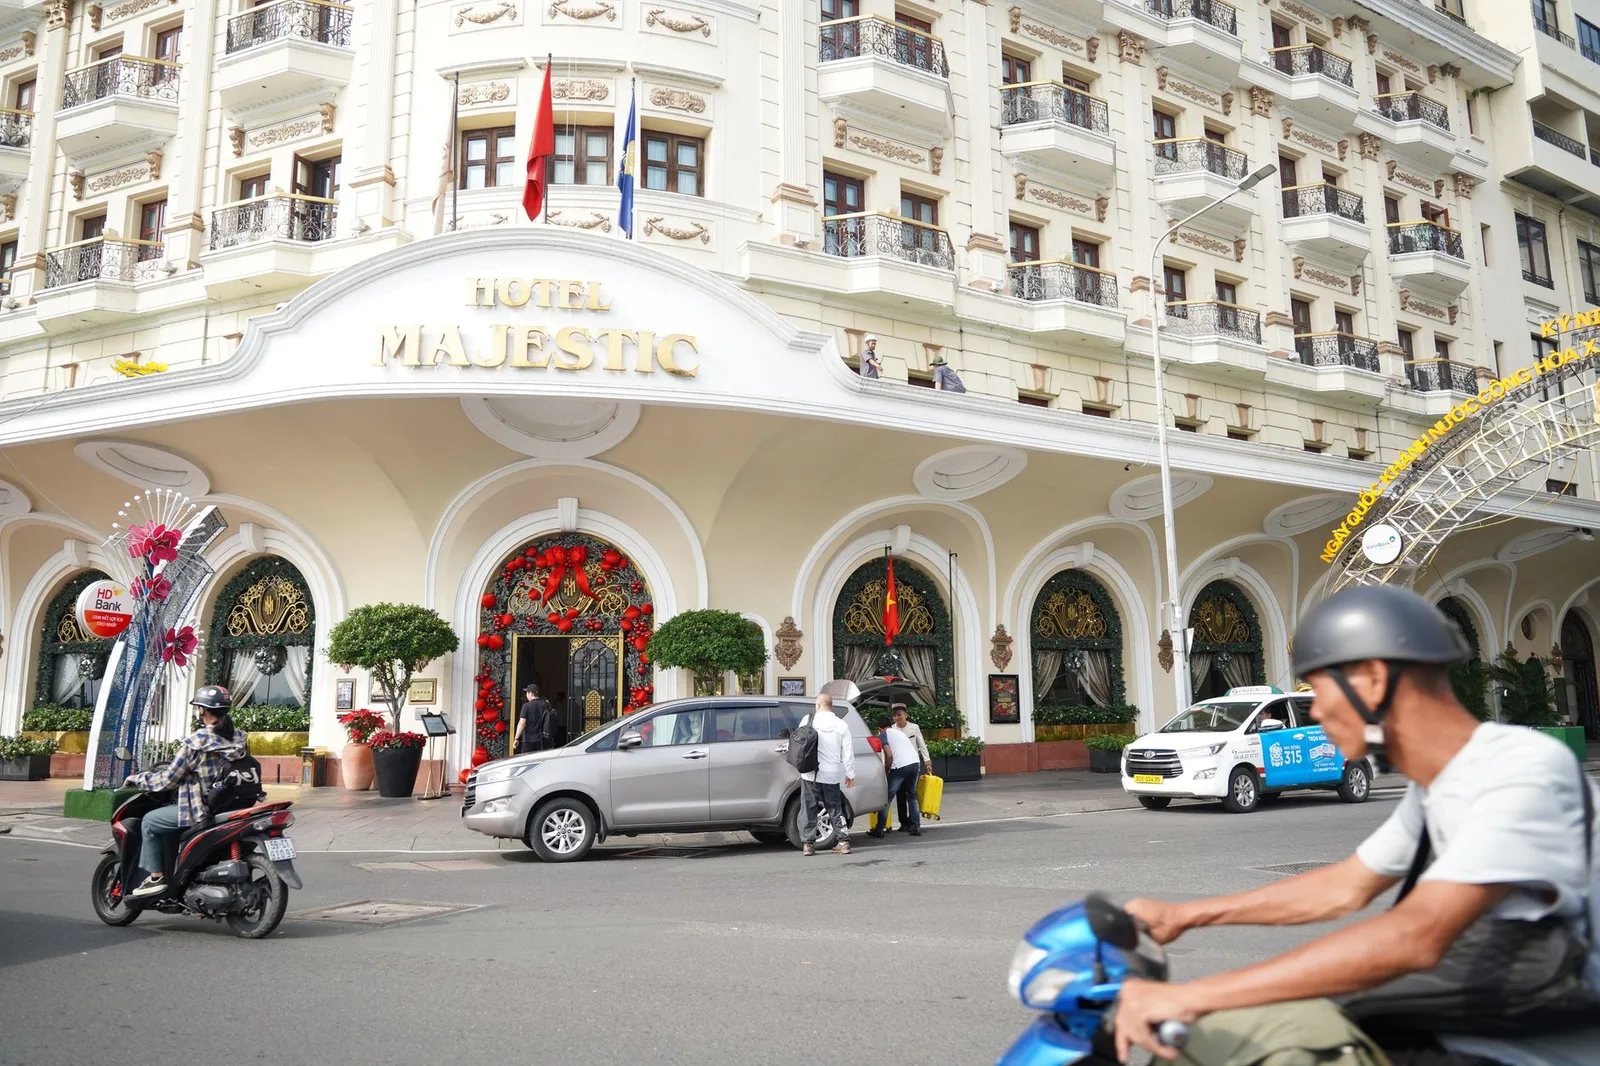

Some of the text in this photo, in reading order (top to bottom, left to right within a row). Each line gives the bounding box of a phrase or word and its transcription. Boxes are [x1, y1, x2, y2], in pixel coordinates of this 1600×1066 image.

[465, 276, 613, 312] HOTEL
[1541, 311, 1571, 338] KỶ
[372, 323, 699, 379] MAJESTIC
[1320, 521, 1351, 564] NGÀY
[1346, 482, 1385, 527] QUỐC
[1379, 433, 1433, 486] KHÁNH
[1427, 397, 1480, 441] NƯỚC
[1478, 367, 1532, 404] CỘNG
[1533, 347, 1581, 376] HÒA
[95, 599, 121, 612] Bank
[96, 588, 113, 600] HD
[1283, 750, 1303, 764] 315
